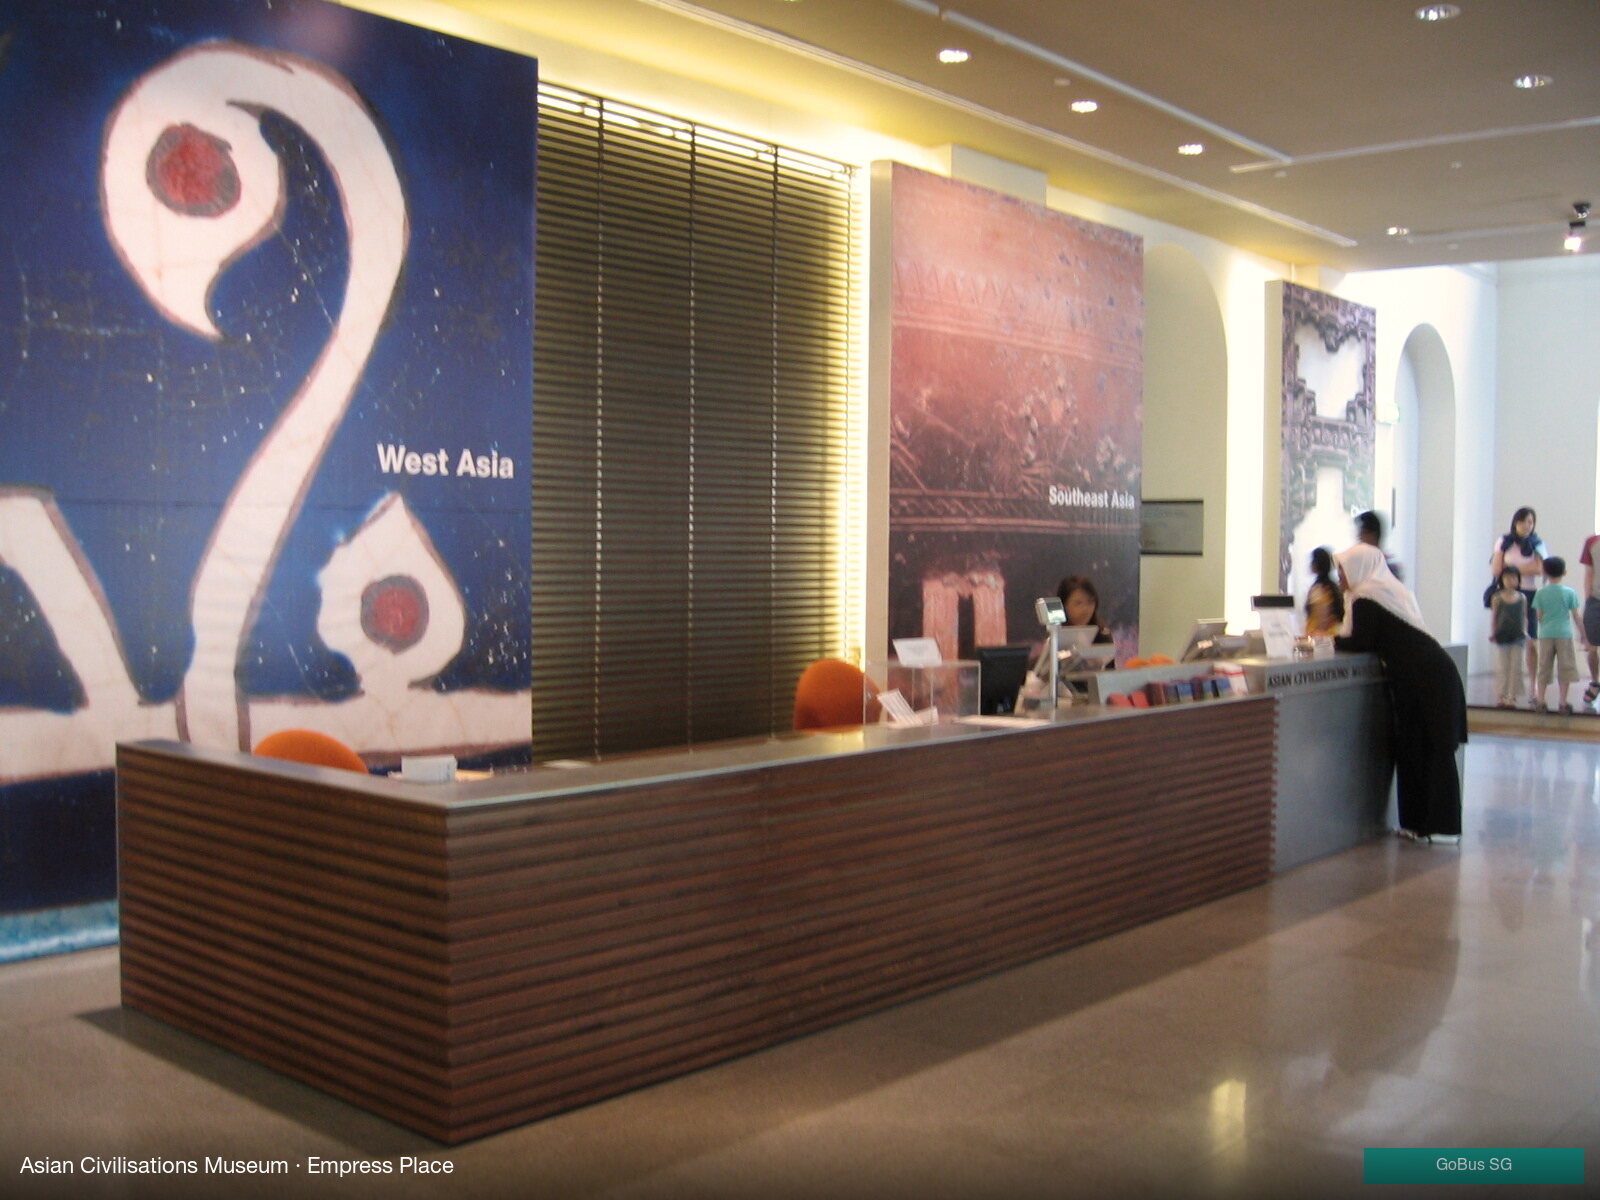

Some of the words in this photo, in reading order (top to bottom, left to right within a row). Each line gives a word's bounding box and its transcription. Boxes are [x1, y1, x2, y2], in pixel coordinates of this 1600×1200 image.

[377, 442, 449, 476] West
[456, 448, 514, 479] Asia
[1048, 484, 1109, 508] Southeast
[1111, 489, 1135, 510] Asia
